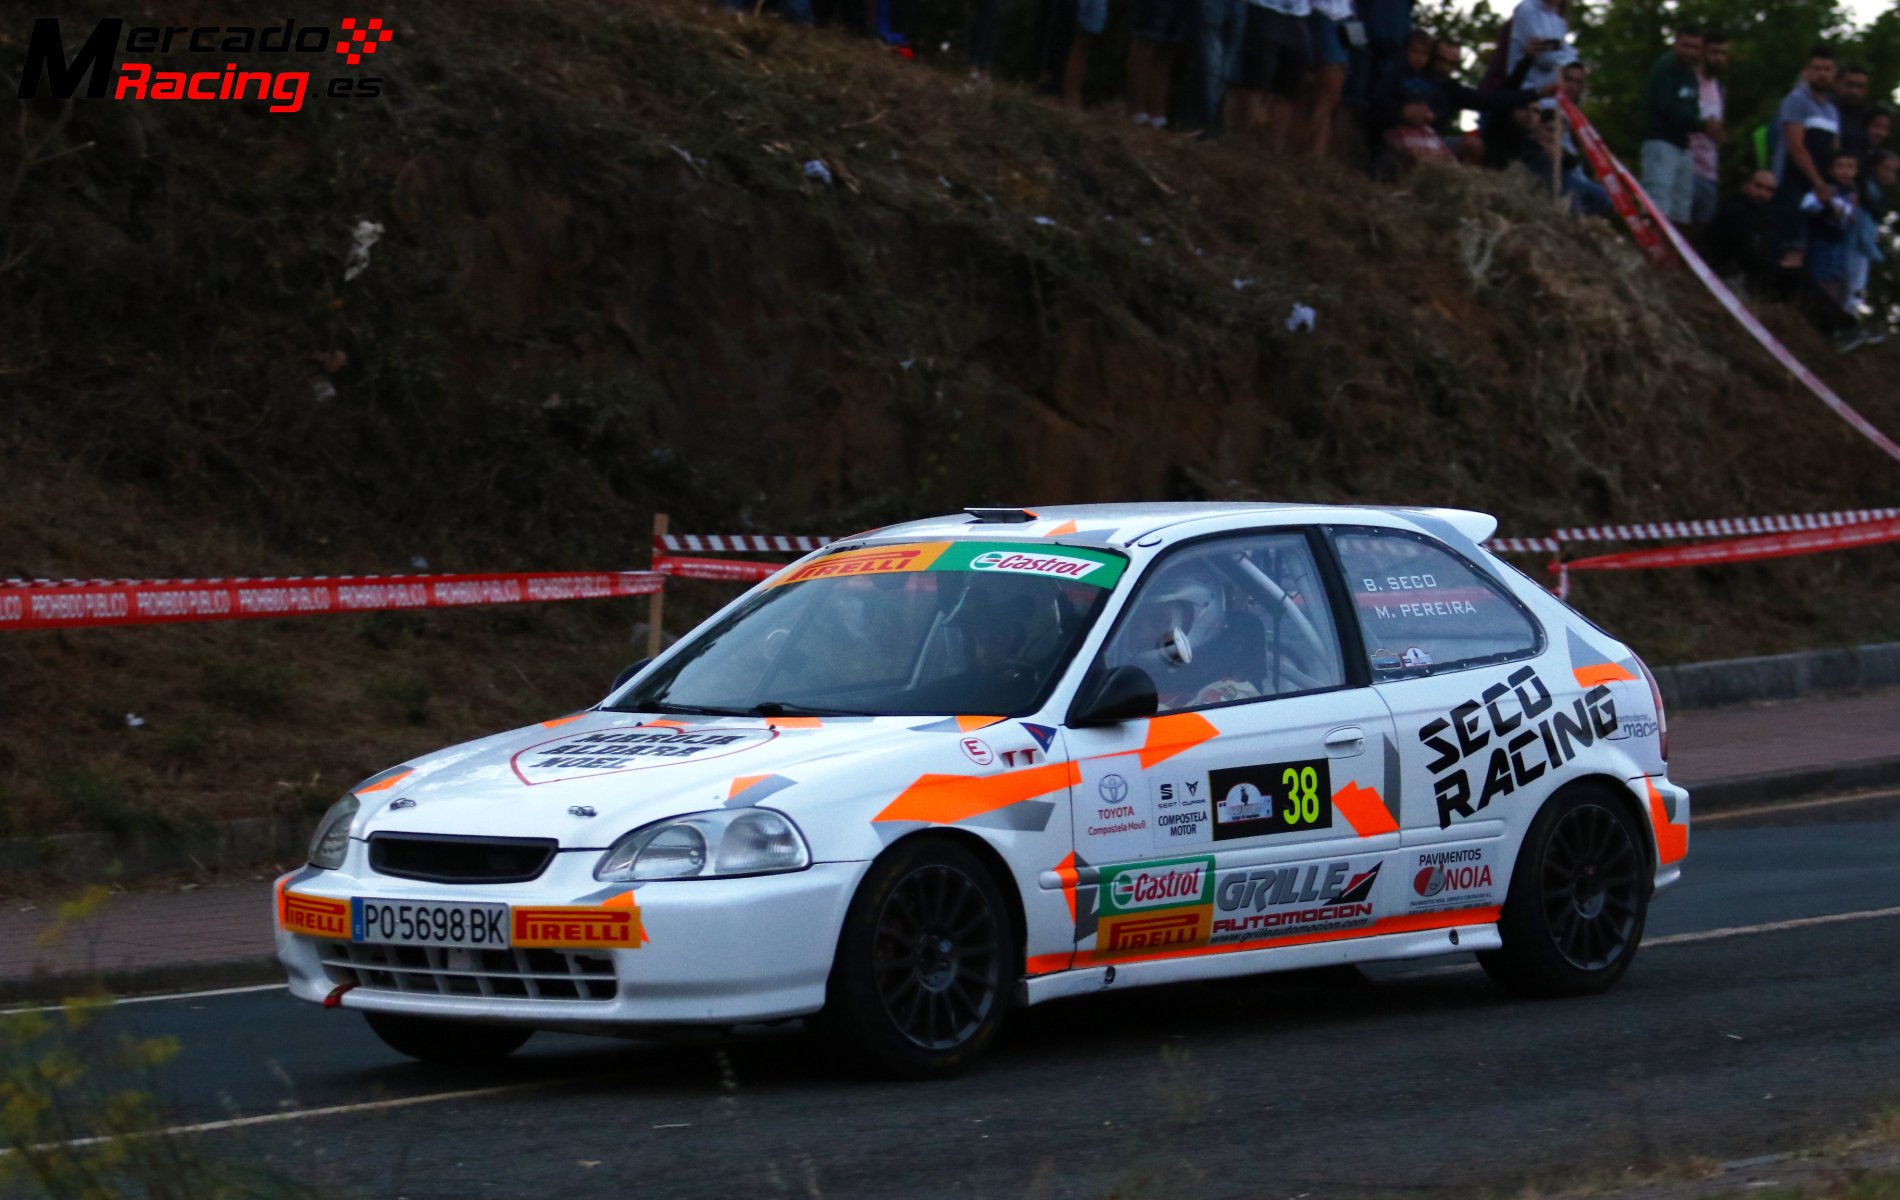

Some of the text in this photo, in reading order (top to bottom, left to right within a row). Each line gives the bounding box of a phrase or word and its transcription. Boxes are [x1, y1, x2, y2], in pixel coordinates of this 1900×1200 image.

[785, 550, 921, 581] PIRELLI
[999, 553, 1091, 576] Castrol
[1363, 574, 1437, 592] B. SECO
[1374, 600, 1477, 619] M. PEREIRA
[1418, 665, 1552, 774] SECO
[537, 745, 708, 757] ALDARA
[572, 733, 747, 745] MARUJA
[964, 740, 986, 756] E
[528, 757, 638, 769] NOEL
[1433, 684, 1618, 831] RACING
[1282, 766, 1319, 825] 38
[1097, 807, 1135, 820] TOYOTA
[1158, 811, 1208, 826] COMPOSTELA
[1088, 823, 1127, 836] Compostela
[1170, 824, 1197, 837] MOTOR
[1420, 848, 1482, 866] PAVIMENTOS
[1134, 867, 1200, 902] Castrol
[1216, 862, 1351, 912] GRILLE
[1445, 864, 1492, 891] NOIA
[285, 895, 345, 933] PIRELLI
[398, 906, 465, 942] 5698
[470, 909, 505, 944] BK
[515, 910, 631, 941] PIRELLI
[1213, 903, 1373, 933] AUTOMOCION
[1108, 913, 1200, 950] PIRELLI
[1211, 917, 1367, 944] www.grilleautomocion.com
